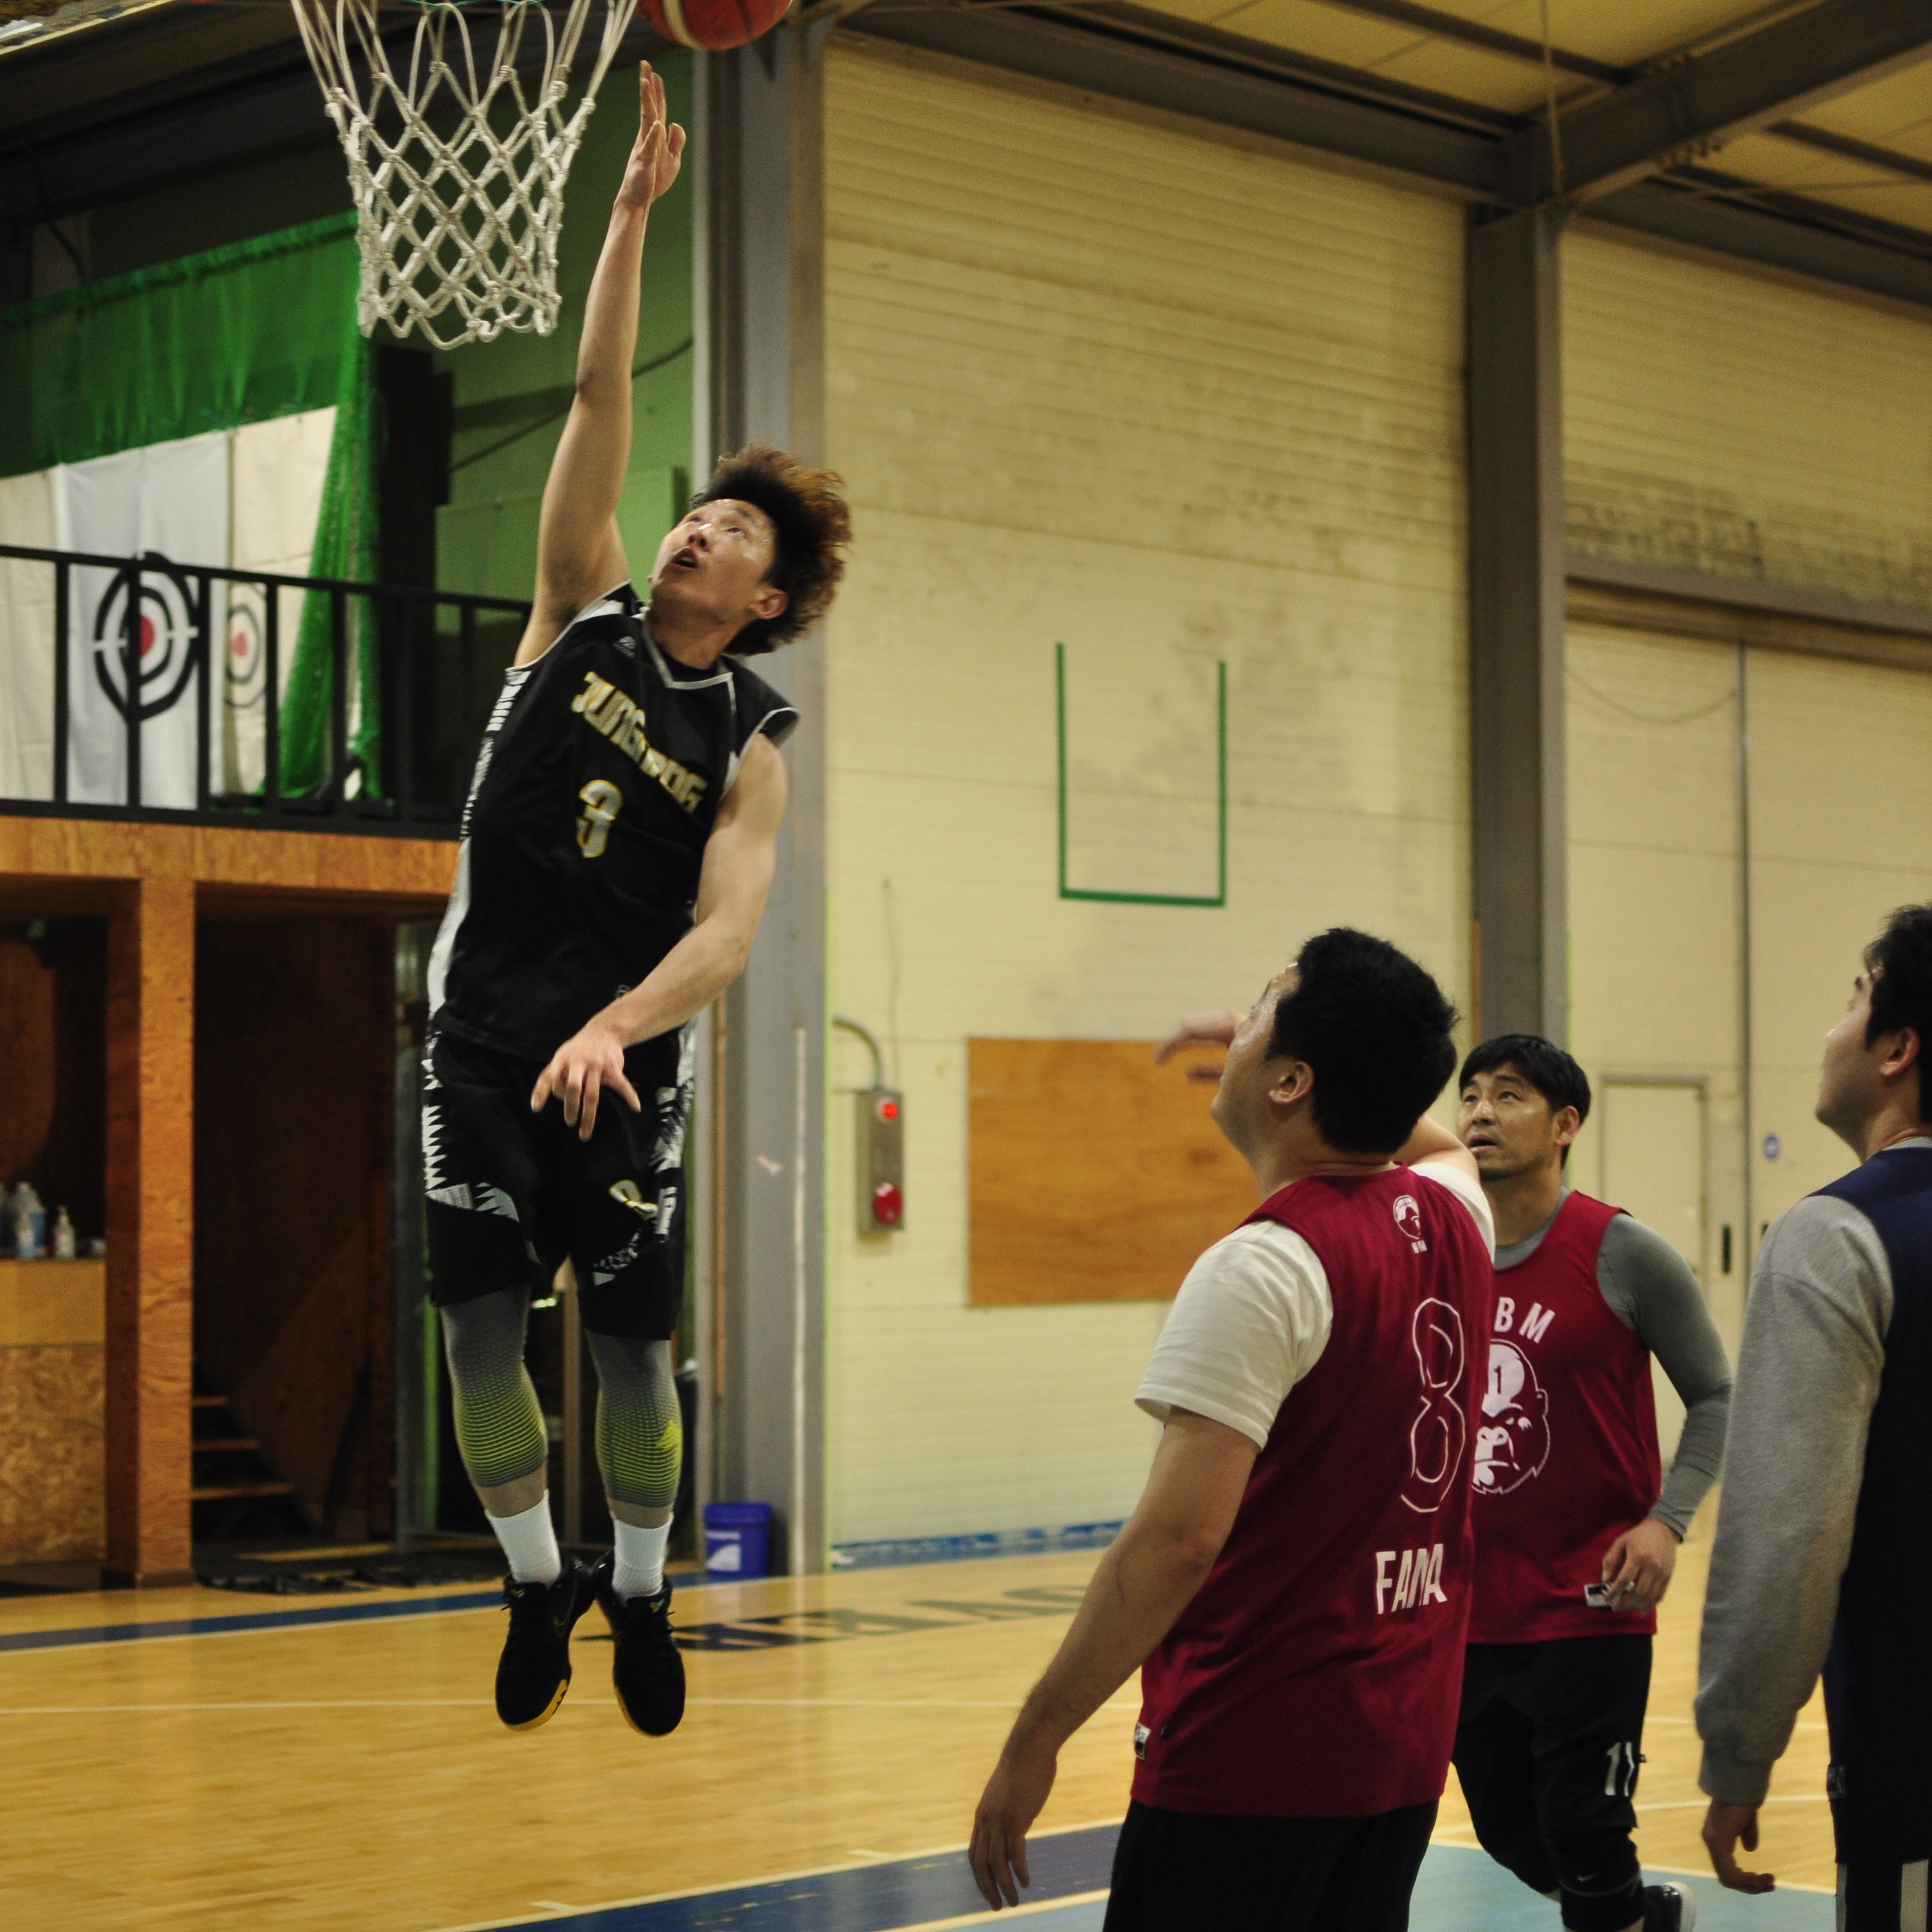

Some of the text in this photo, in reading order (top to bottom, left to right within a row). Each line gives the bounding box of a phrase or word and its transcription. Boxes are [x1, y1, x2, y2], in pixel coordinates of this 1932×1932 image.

[575, 779, 623, 859] 3
[1402, 1297, 1465, 1513] 8
[1604, 1741, 1636, 1797] 11
